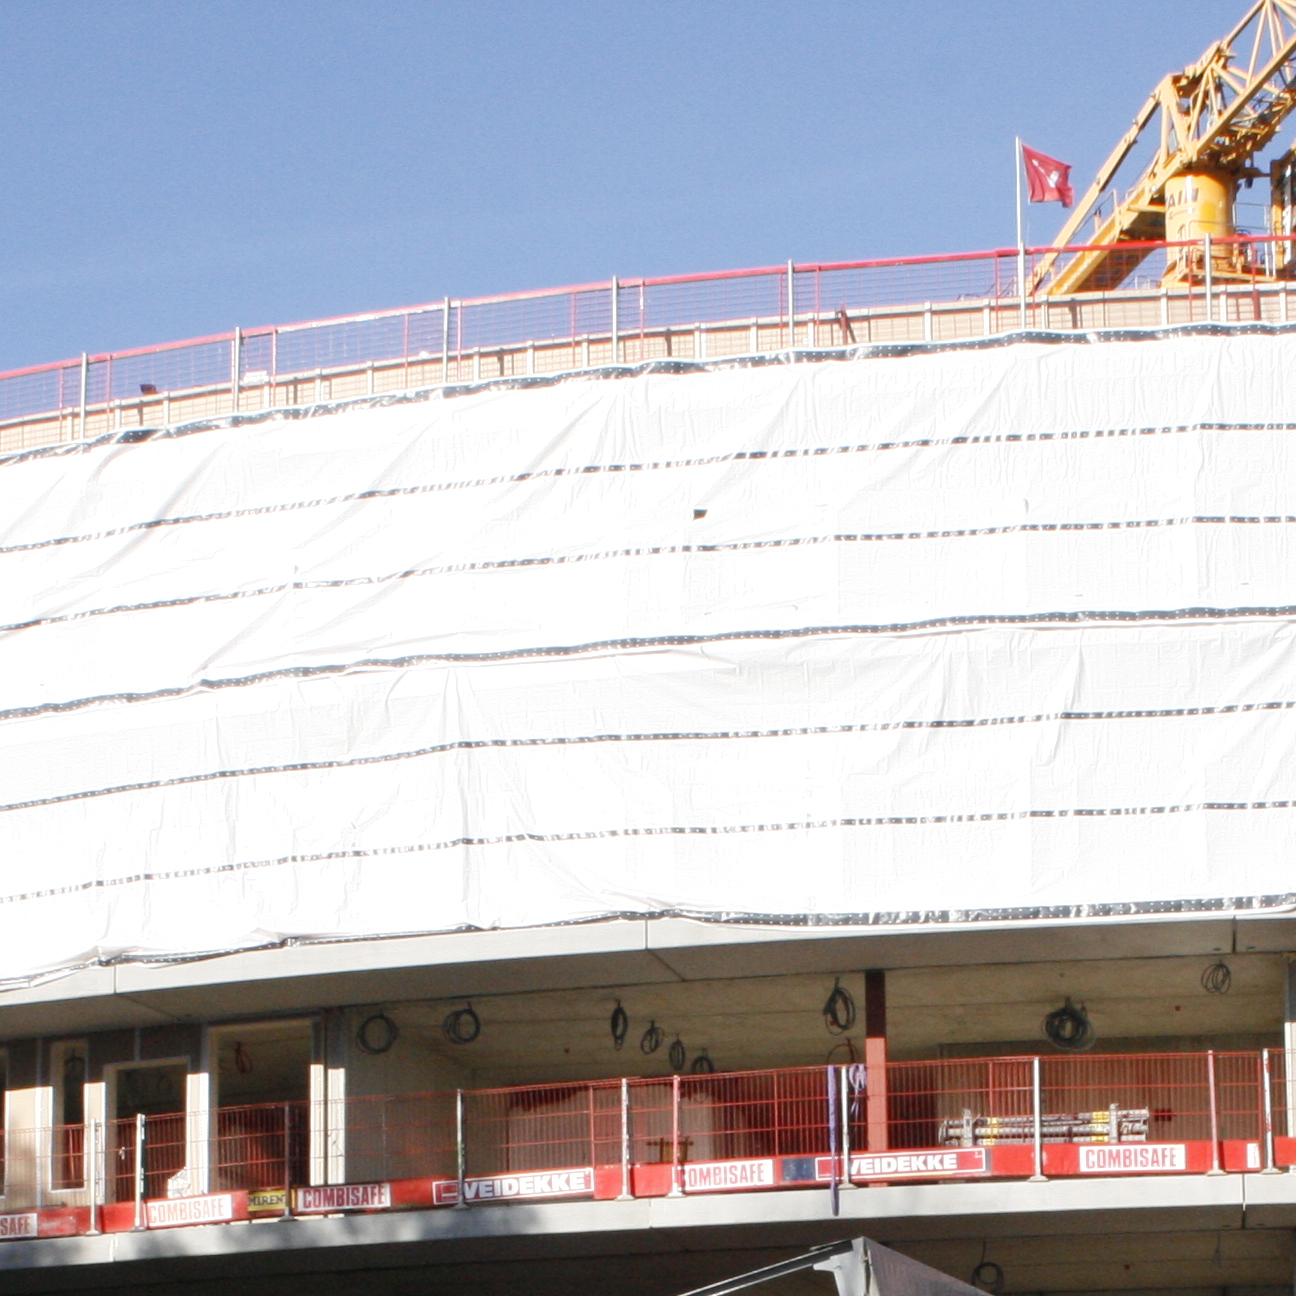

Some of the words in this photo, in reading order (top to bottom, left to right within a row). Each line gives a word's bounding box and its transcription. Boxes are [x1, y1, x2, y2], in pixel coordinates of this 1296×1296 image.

[851, 1154, 957, 1176] VEIDEKKE
[1085, 1147, 1177, 1169] COMBISAFE
[304, 1185, 386, 1209] COMBISAFE
[463, 1171, 586, 1200] VEIDEKKE
[148, 1198, 225, 1224] COMBISAFE
